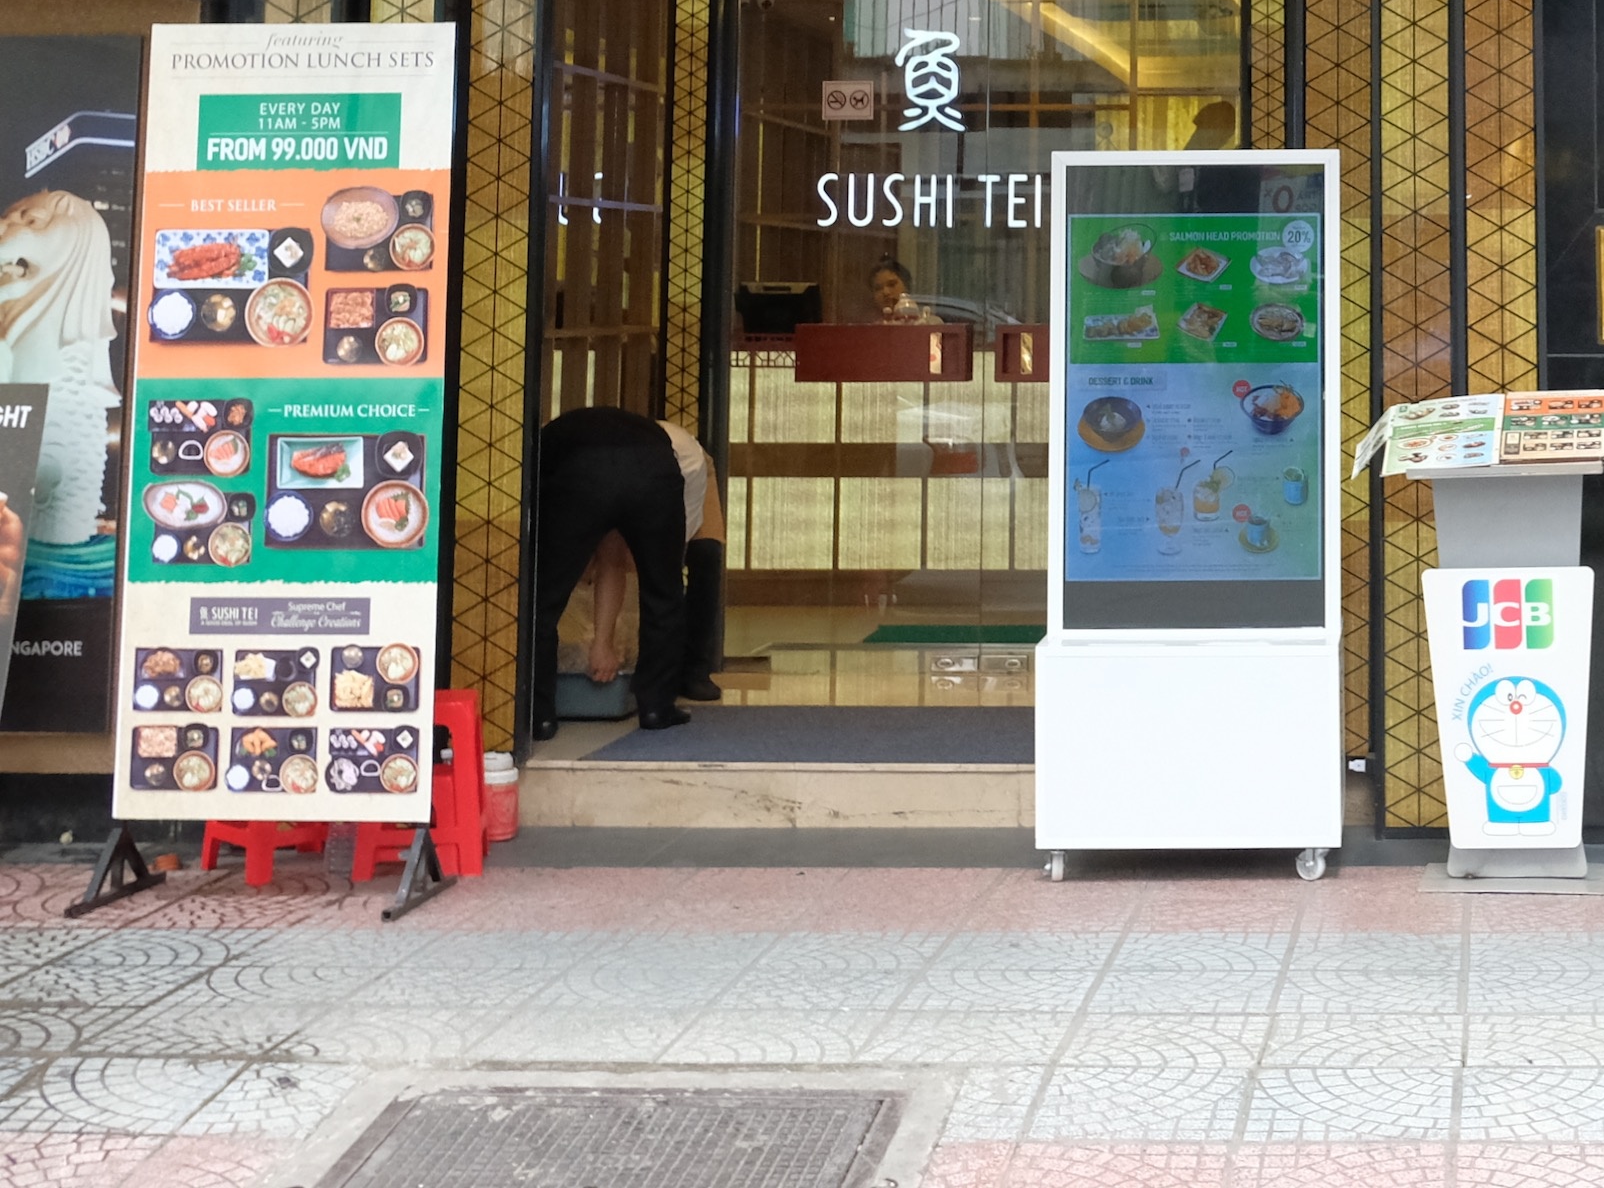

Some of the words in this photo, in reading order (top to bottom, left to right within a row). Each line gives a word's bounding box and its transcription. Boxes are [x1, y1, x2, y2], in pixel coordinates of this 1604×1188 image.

[264, 31, 344, 51] featuring
[171, 52, 300, 71] PROMOTION
[306, 52, 382, 69] LUNCH
[388, 51, 435, 68] SETS
[259, 102, 306, 116] EVERY
[310, 101, 341, 115] DAY
[258, 117, 298, 130] 11AM
[311, 116, 341, 130] 5PM
[206, 137, 267, 161] FROM
[271, 137, 339, 160] 99.000
[344, 136, 388, 160] VND
[191, 199, 224, 213] BEST
[227, 198, 277, 212] SELLER
[816, 173, 954, 228] SUSHI
[977, 173, 1042, 228] TEI
[1169, 231, 1205, 242] SALMON
[1206, 231, 1229, 241] HEAD
[1230, 230, 1281, 241] PROMOTION
[1287, 230, 1312, 244] 20%
[1088, 376, 1122, 386] DESSERT
[1130, 376, 1154, 386] DRINK
[283, 404, 354, 418] PREMIUM
[356, 403, 416, 417] CHOICE
[211, 606, 240, 620] SUSHI
[241, 606, 259, 620] TEI
[287, 601, 325, 613] Supreme
[326, 601, 347, 611] Chef
[1451, 698, 1466, 722] XIN
[1459, 662, 1495, 695] CHÀO!
